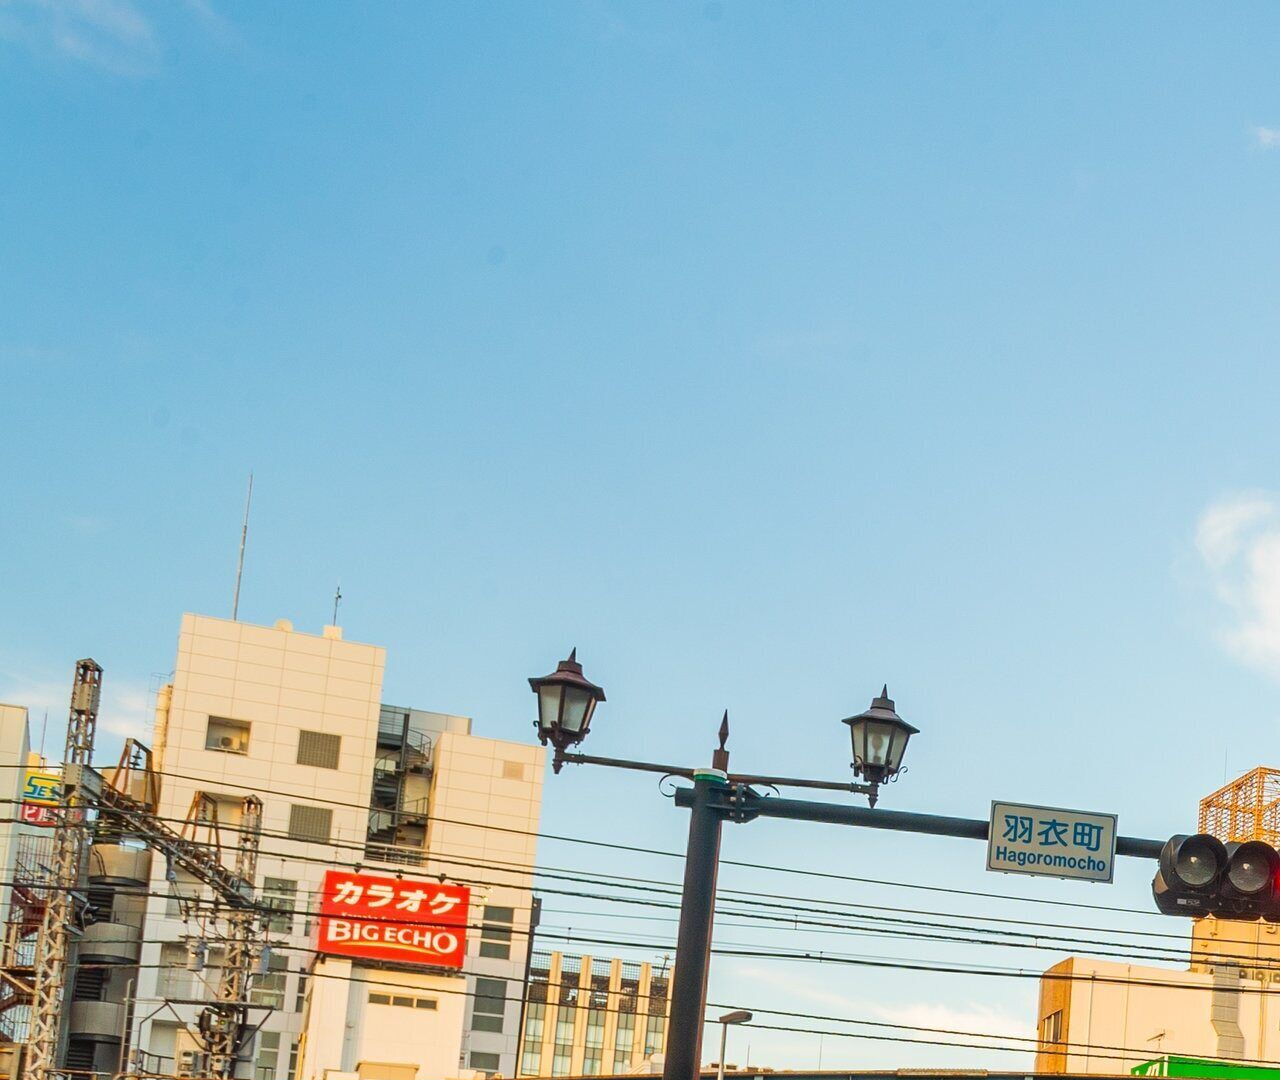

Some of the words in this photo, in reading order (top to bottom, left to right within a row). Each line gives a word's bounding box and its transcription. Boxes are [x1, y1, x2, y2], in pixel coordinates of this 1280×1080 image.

[1002, 814, 1104, 852] 羽衣町
[995, 845, 1106, 872] Hagoromocho
[332, 881, 461, 915] カラオケ
[326, 918, 380, 942] BIG
[383, 926, 459, 955] ECHO
